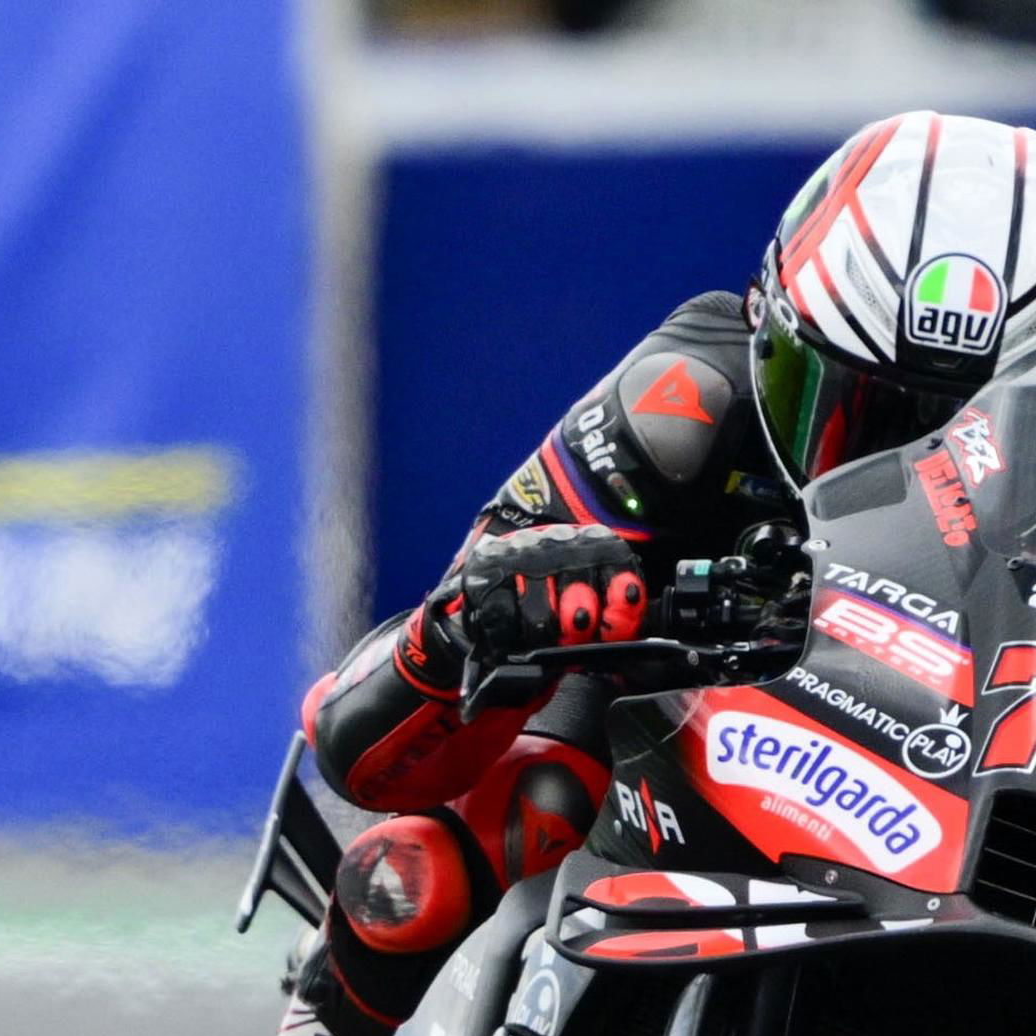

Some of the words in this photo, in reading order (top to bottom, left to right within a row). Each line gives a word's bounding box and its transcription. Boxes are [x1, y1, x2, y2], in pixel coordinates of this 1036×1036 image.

[918, 307, 989, 347] agv
[823, 562, 961, 635] TARGA
[819, 598, 963, 677] BS
[785, 666, 911, 742] PRAGMATIC
[910, 735, 966, 768] PLAY
[717, 722, 922, 855] sterilgarda
[760, 794, 833, 844] alimenti
